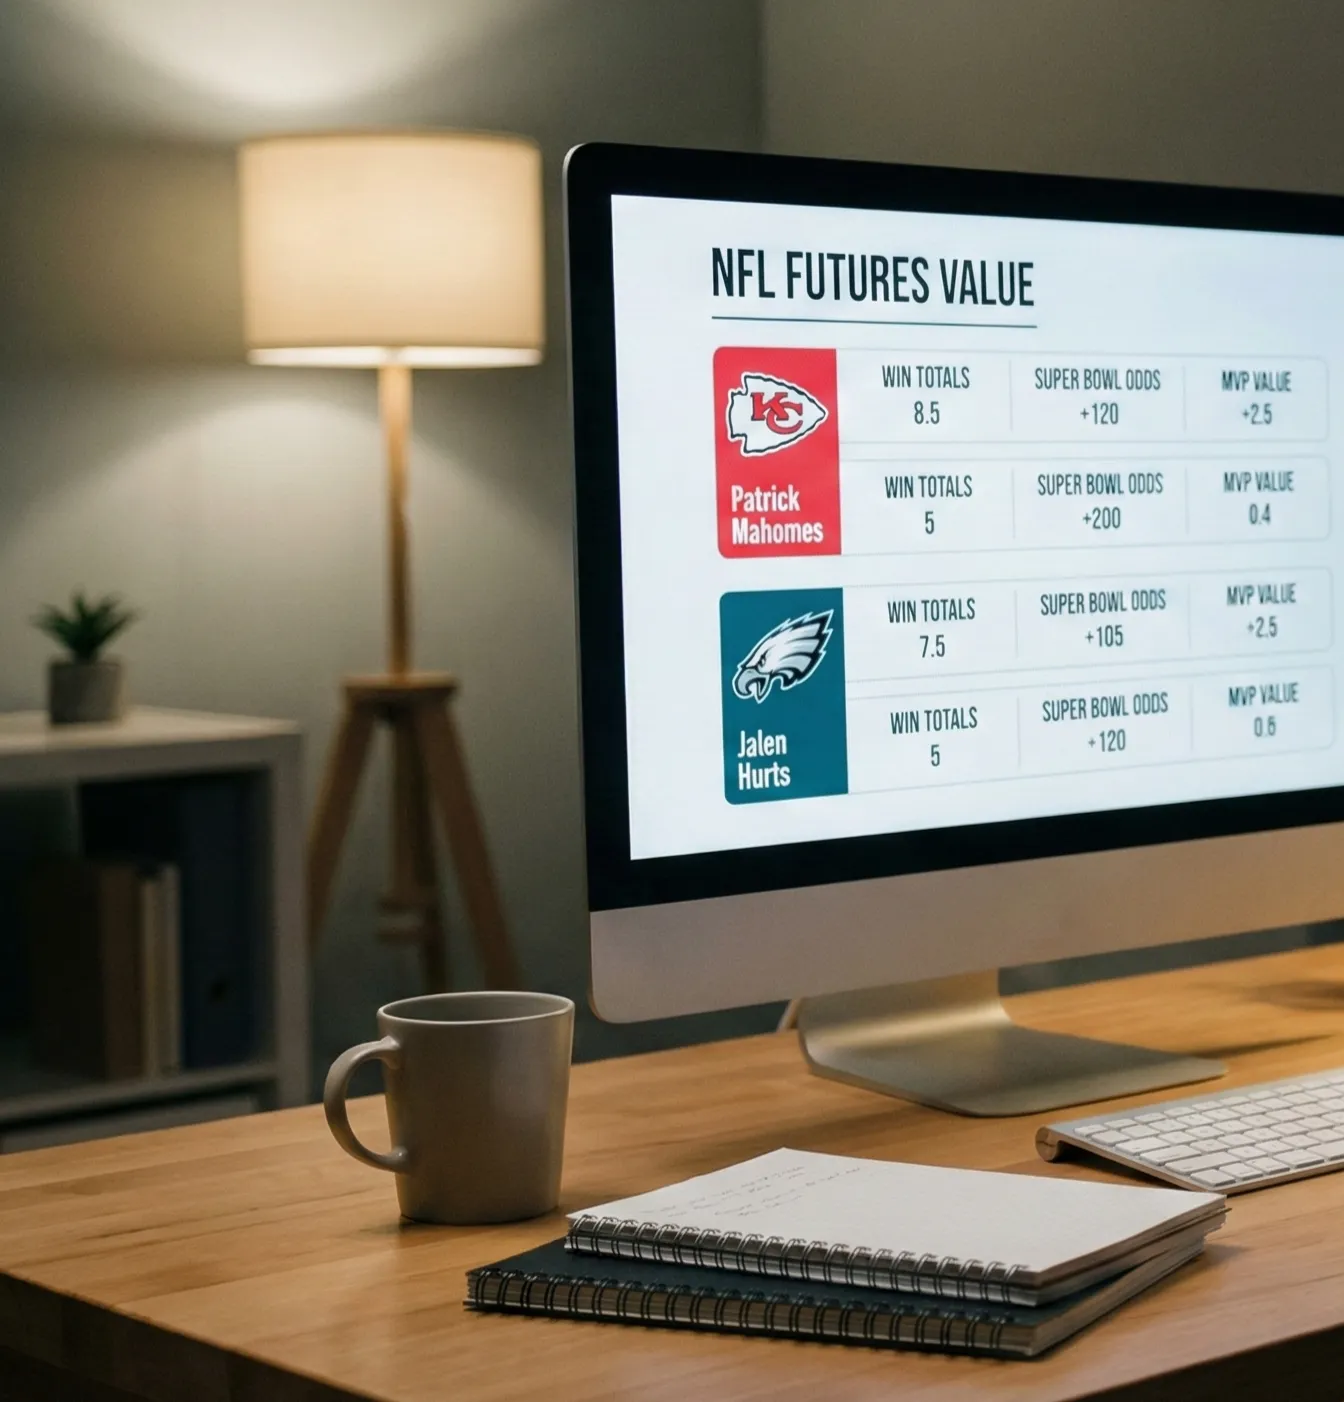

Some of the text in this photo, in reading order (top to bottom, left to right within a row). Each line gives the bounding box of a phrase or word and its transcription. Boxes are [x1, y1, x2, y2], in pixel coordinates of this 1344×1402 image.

[711, 246, 1035, 307] NFL FUTURES VALUE
[881, 364, 971, 390] WIN TOTALS
[1034, 367, 1161, 391] SUPER BOWL ODDS
[1221, 370, 1292, 393] MVP VALUE
[750, 391, 803, 435] KC
[913, 400, 941, 425] 8.5
[1080, 402, 1119, 425] +120
[1241, 402, 1273, 425] +2.5
[884, 474, 973, 499] WIN TOTALS
[1037, 472, 1164, 497] SUPER BOWL ODDS
[1223, 470, 1294, 493] MVP VALUE
[731, 484, 800, 513] Patrick
[924, 510, 935, 535] 5
[1082, 506, 1121, 530] +200
[1249, 502, 1271, 526] 0.4
[731, 516, 824, 545] Mahomes
[1040, 588, 1167, 616] SUPER BOWL ODDS
[1226, 582, 1297, 606] MVP VALUE
[887, 597, 976, 624] WIN TOTALS
[1085, 624, 1124, 648] +105
[1247, 615, 1278, 639] +2.5
[919, 633, 946, 659] 7.5
[1042, 691, 1169, 723] SUPER BOWL ODDS
[1228, 682, 1299, 708] MVP VALUE
[890, 705, 978, 735] WIN TOTALS
[736, 728, 787, 758] Jalen
[1088, 728, 1126, 753] +120
[930, 743, 941, 767] 5
[737, 761, 791, 791] Hurts
